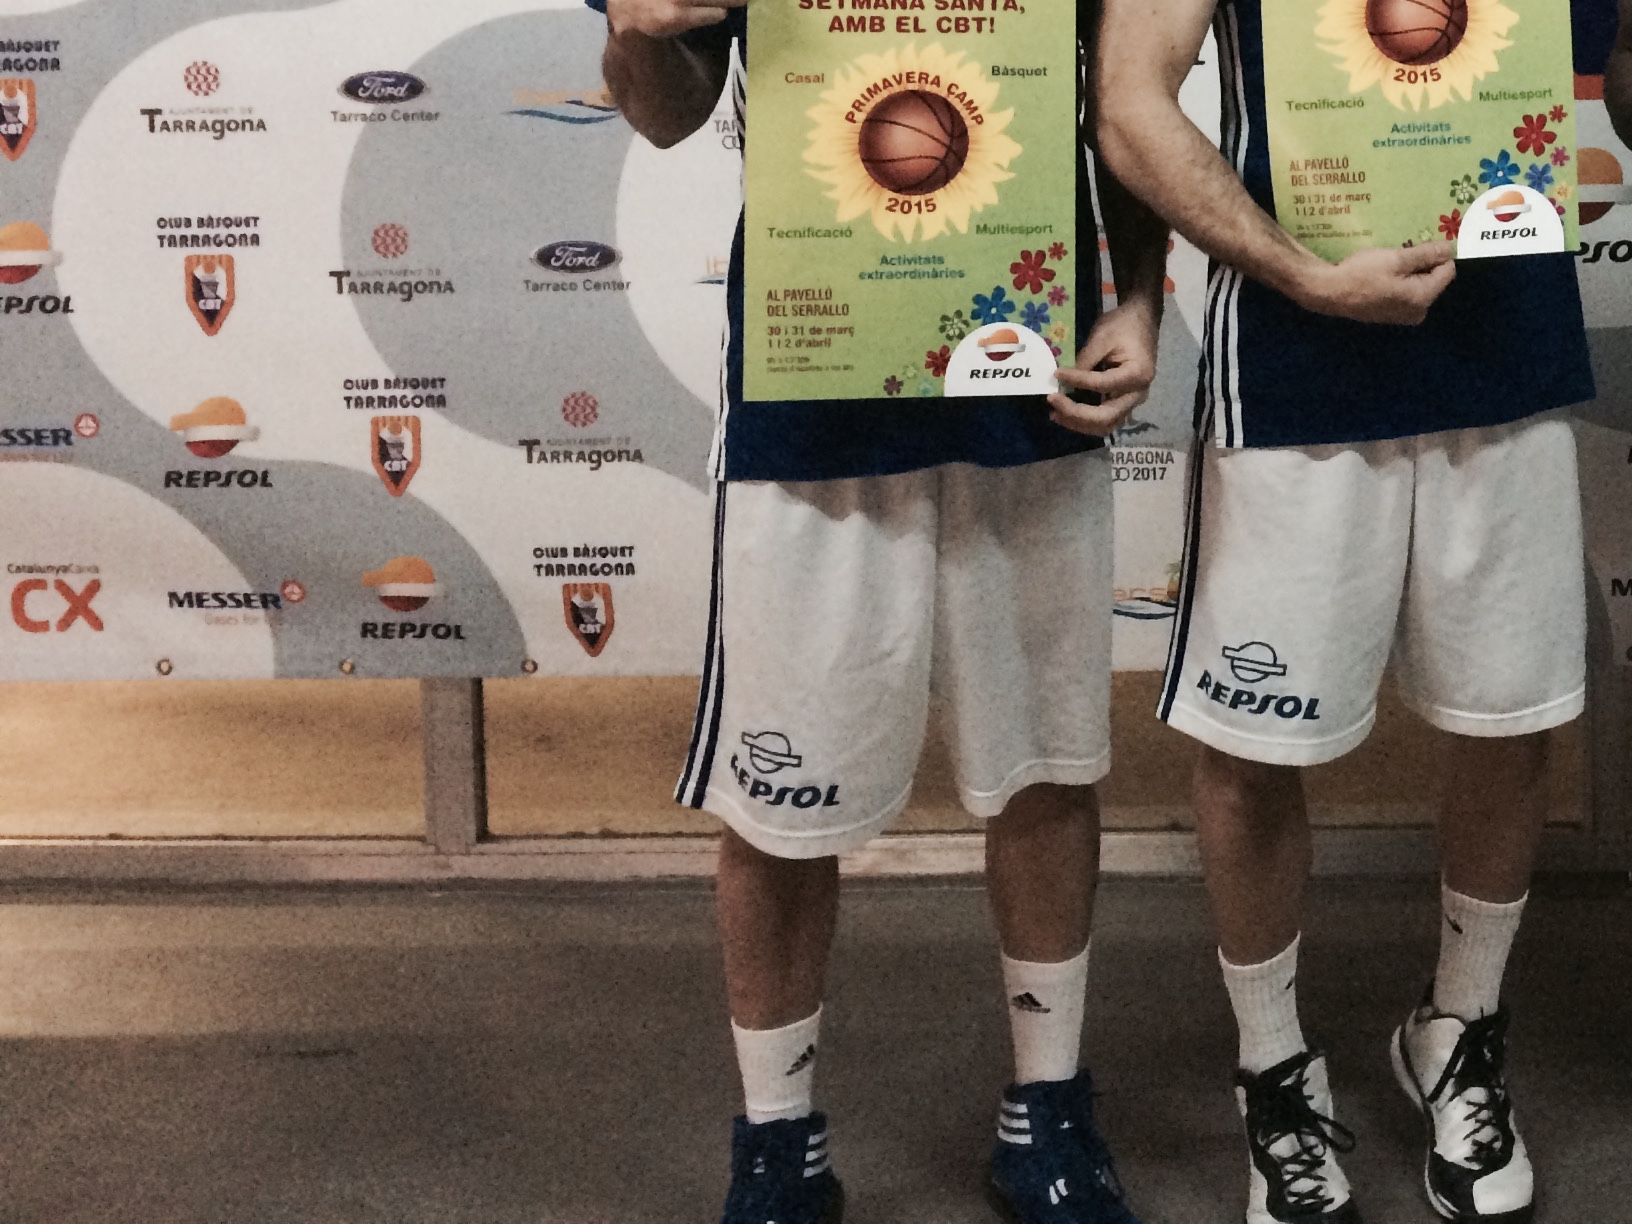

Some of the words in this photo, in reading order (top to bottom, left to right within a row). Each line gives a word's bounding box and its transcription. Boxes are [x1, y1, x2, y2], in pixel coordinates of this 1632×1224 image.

[829, 16, 885, 33] AMB
[896, 16, 927, 33] EL
[936, 16, 995, 33] CBT!
[785, 72, 825, 84] Casal
[991, 65, 1047, 79] Bàsquet
[1393, 67, 1441, 84] 2015
[845, 71, 941, 125] PRIMAVERA
[946, 82, 984, 127] CAMP
[1479, 87, 1553, 102] Multiesport
[1286, 97, 1365, 112] Tecnificació
[1390, 121, 1451, 134] Activitats
[1372, 133, 1472, 149] extraordinàries
[1313, 171, 1366, 185] SERRALLO
[885, 197, 937, 215] 2015
[767, 226, 853, 239] Tecnificació
[975, 223, 1053, 237] Multiesport
[1480, 227, 1538, 241] REPSOL
[879, 253, 945, 266] Activitats
[858, 267, 965, 281] extraordinàries
[767, 290, 780, 301] AL
[767, 304, 788, 317] DEL
[791, 303, 849, 317] SERRALLO
[969, 368, 1032, 380] REPSOL
[164, 470, 273, 488] REPSOL
[1132, 467, 1167, 481] 2017
[10, 579, 104, 632] CX
[168, 590, 282, 610] MESSER
[360, 622, 465, 641] REPSOL
[1197, 669, 1321, 720] REPSOL
